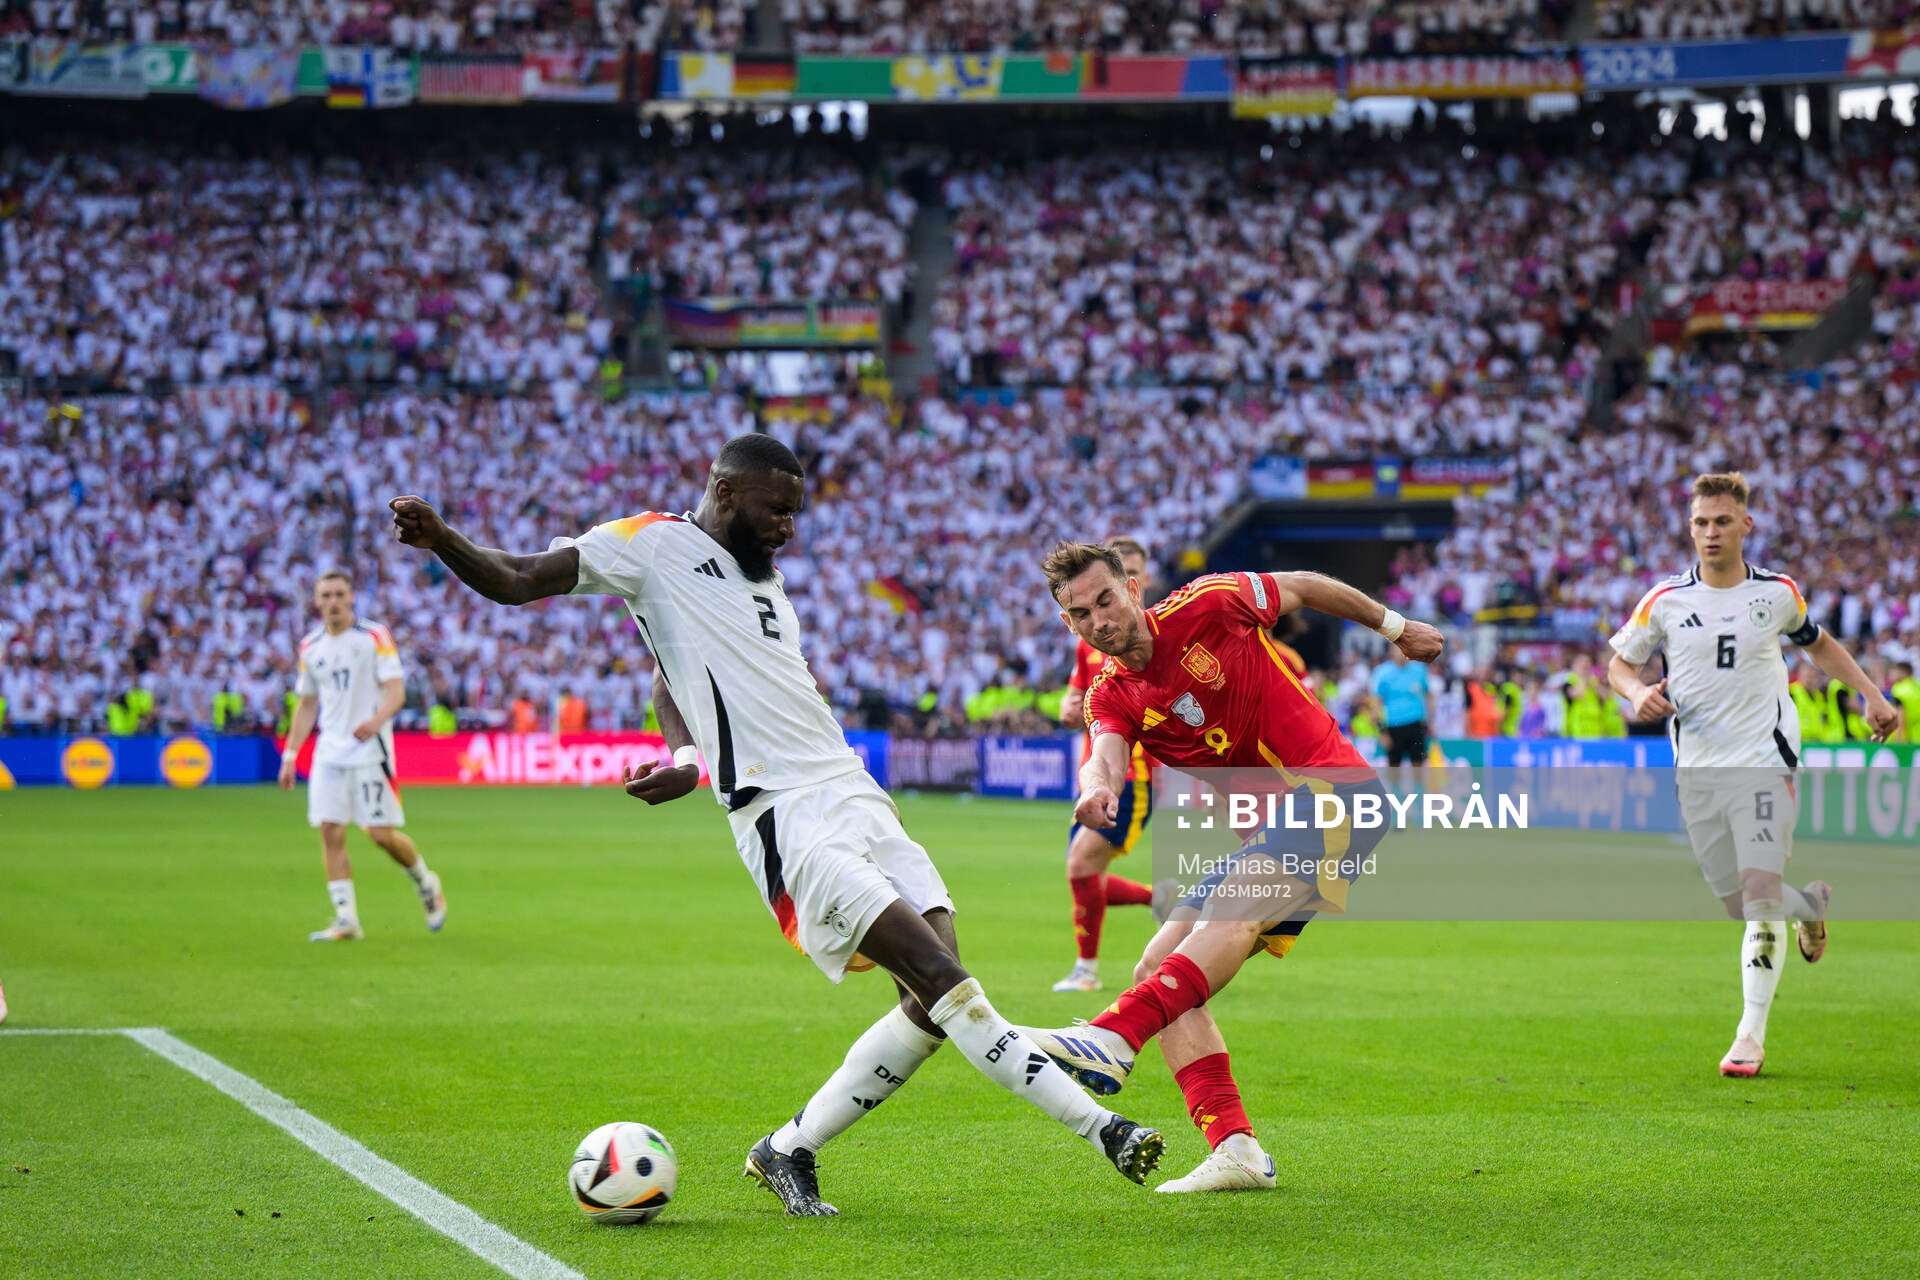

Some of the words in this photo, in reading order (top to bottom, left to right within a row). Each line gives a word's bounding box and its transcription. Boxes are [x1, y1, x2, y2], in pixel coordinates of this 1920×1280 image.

[1587, 50, 1676, 80] 2024
[752, 594, 781, 642] 2
[1716, 634, 1736, 669] 6
[332, 669, 350, 692] 17
[458, 733, 674, 787] AliExpr
[361, 781, 384, 805] 17
[1755, 791, 1773, 820] 6
[985, 1030, 1020, 1064] DFB
[874, 1064, 907, 1088] DF
